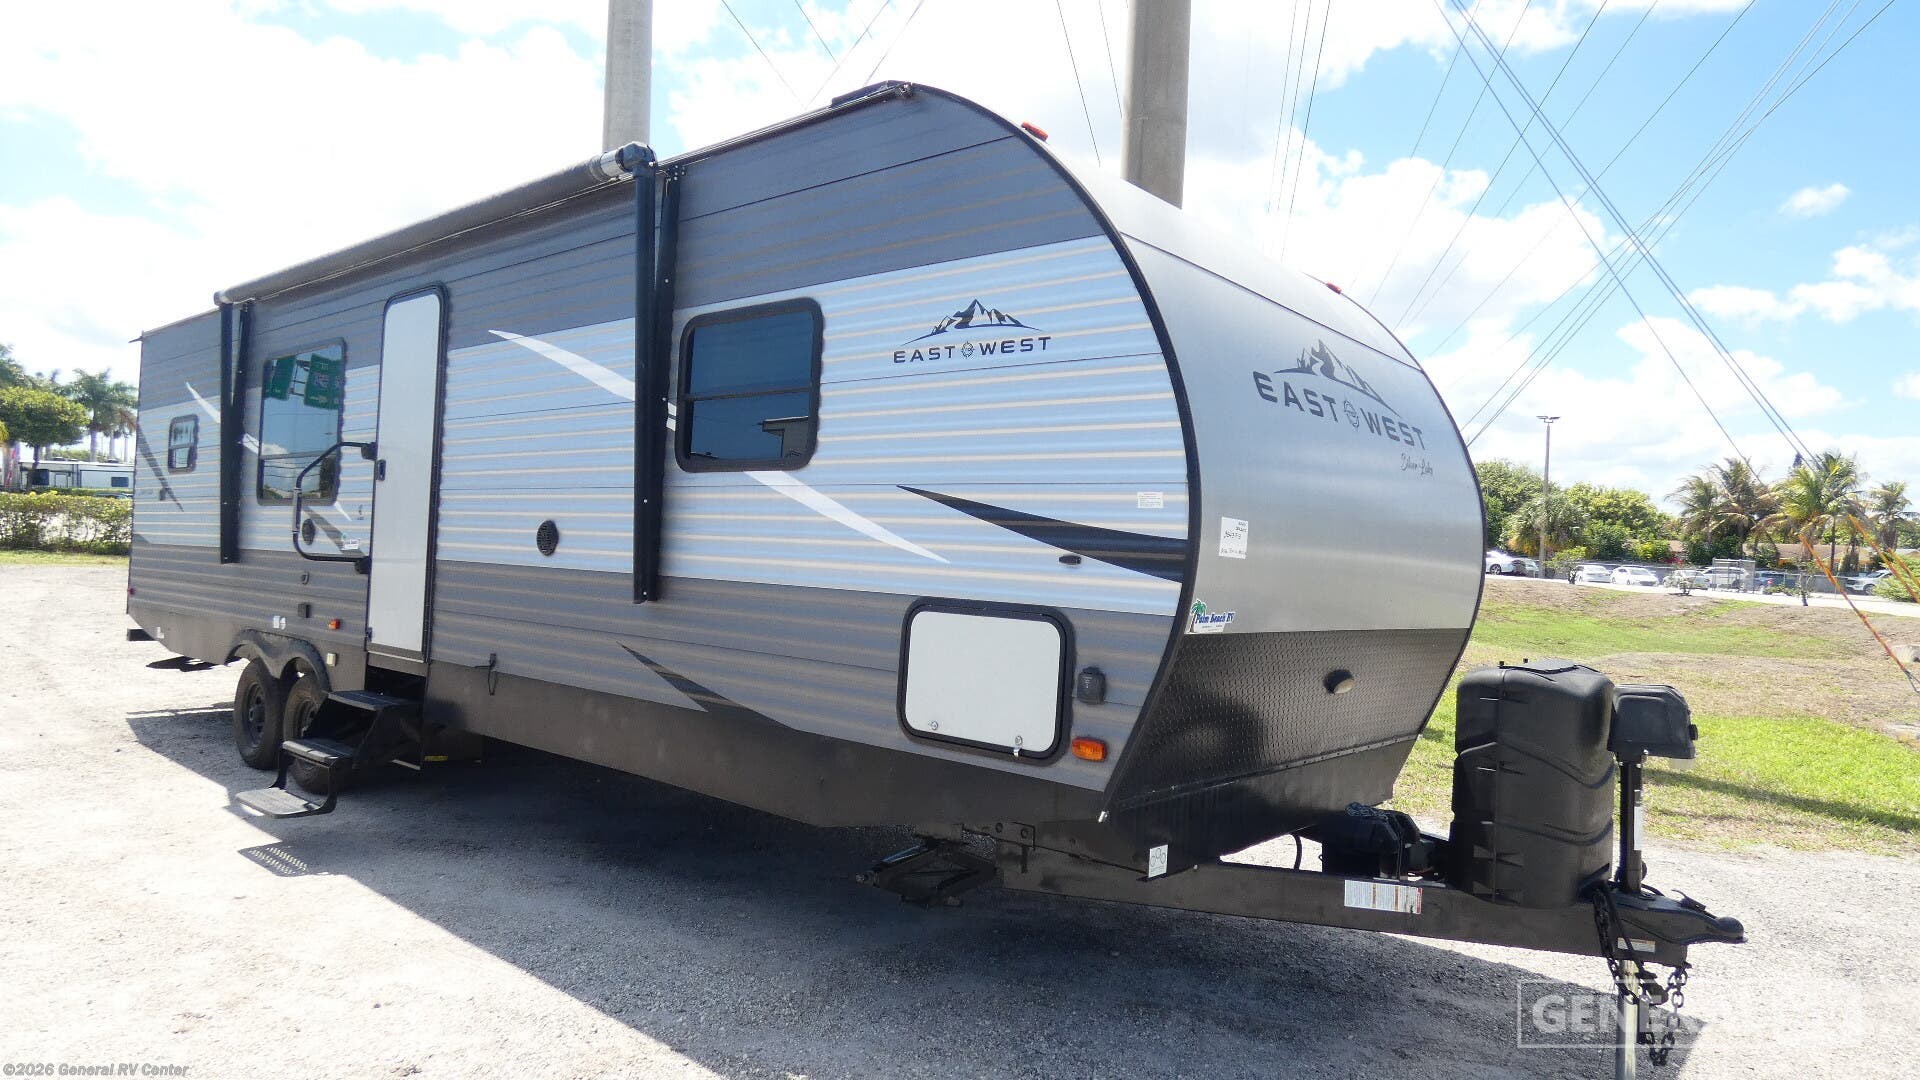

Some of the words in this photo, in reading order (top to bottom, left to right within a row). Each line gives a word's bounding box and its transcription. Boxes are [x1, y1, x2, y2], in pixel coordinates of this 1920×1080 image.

[893, 345, 956, 364] EAST
[978, 336, 1052, 356] WEST
[1252, 370, 1339, 424] EAST
[1360, 407, 1426, 450] WEST
